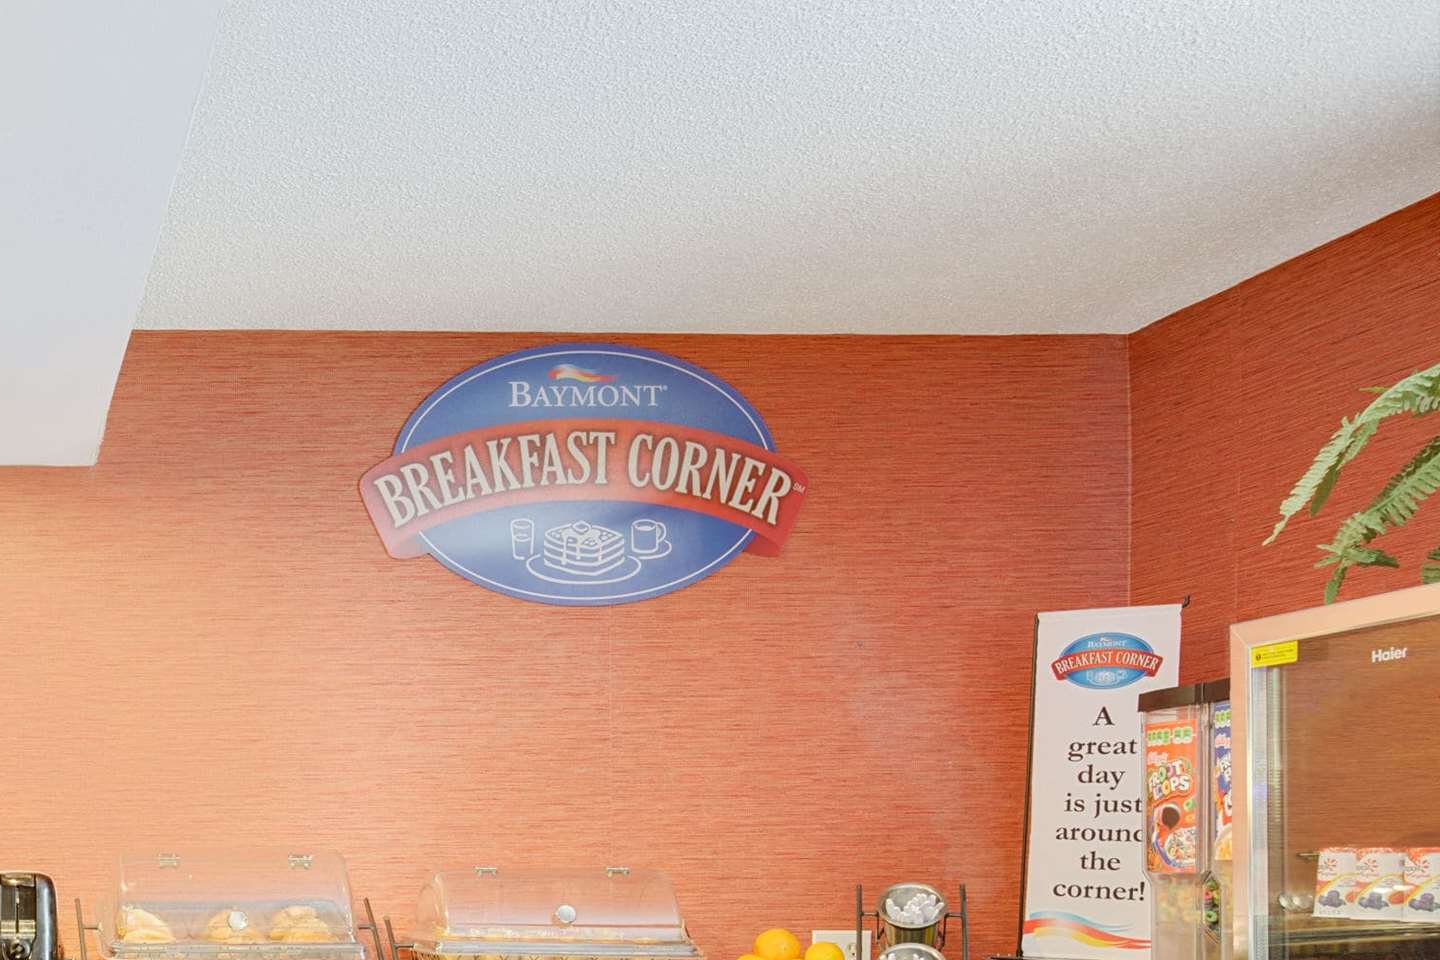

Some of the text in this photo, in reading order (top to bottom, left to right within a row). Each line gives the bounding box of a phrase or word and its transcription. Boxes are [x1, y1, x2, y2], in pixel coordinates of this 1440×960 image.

[508, 381, 663, 408] BAYMONT
[373, 431, 616, 529] BREAKFAST
[627, 432, 792, 526] CORNER
[1054, 651, 1159, 674] BREAKFAST CORNER
[1371, 647, 1408, 663] Haier
[1092, 706, 1115, 726] A
[1068, 738, 1138, 762] great
[1077, 765, 1126, 790] day
[1064, 793, 1143, 819] is just
[1080, 851, 1121, 871] the
[1053, 881, 1145, 901] corner!
